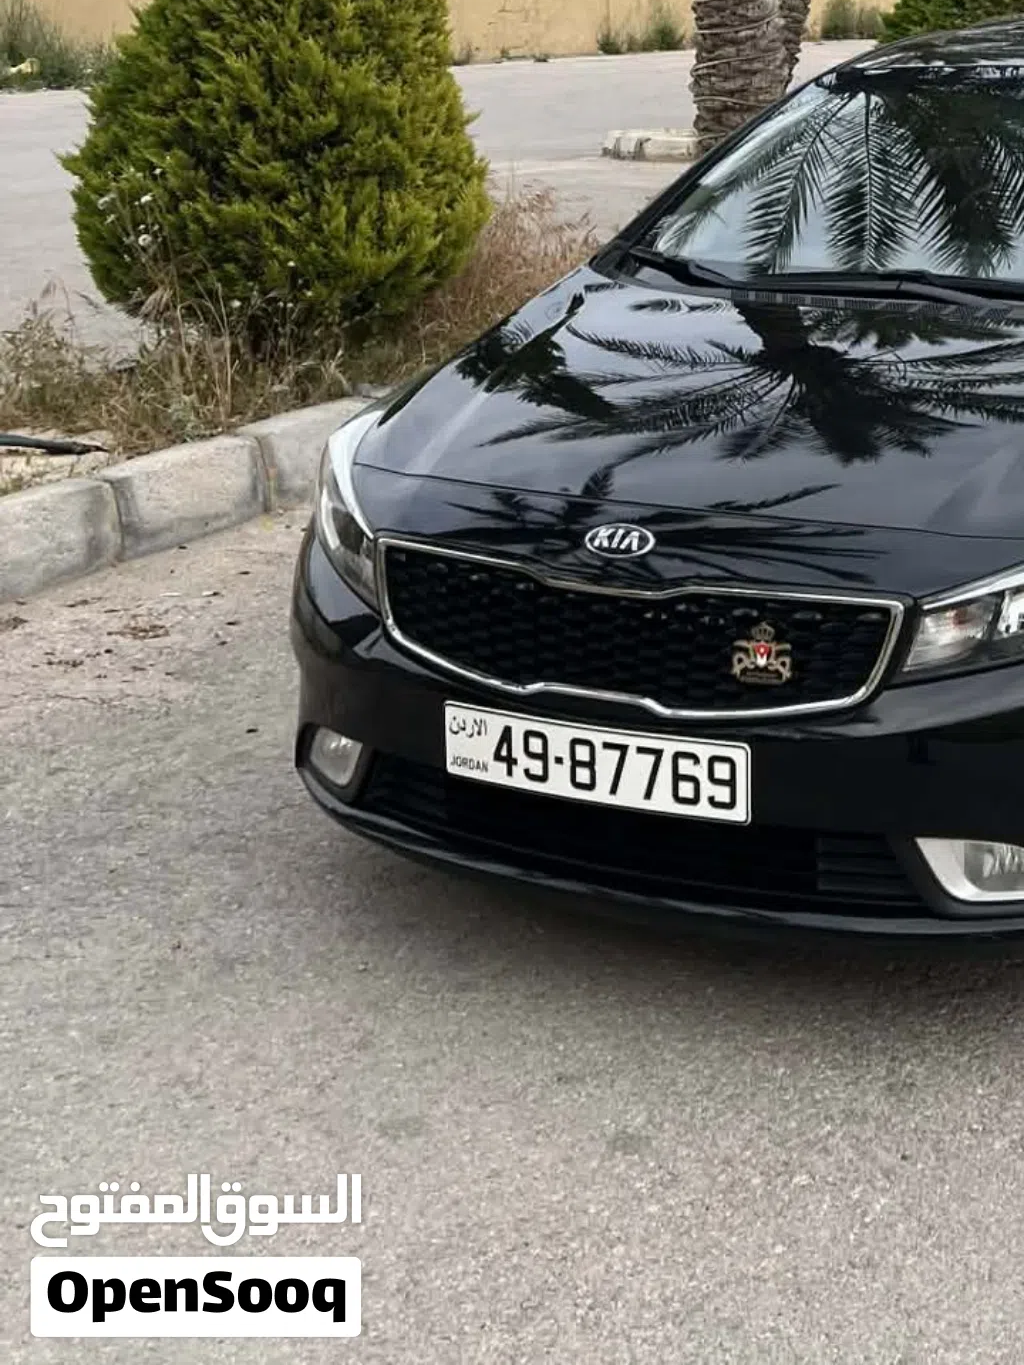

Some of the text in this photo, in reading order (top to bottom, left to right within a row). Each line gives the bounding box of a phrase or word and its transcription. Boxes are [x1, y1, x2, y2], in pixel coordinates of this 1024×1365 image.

[593, 528, 643, 551] KIA
[449, 713, 488, 739] الاردن
[450, 755, 488, 774] JORDAN
[492, 724, 738, 811] 49-87769
